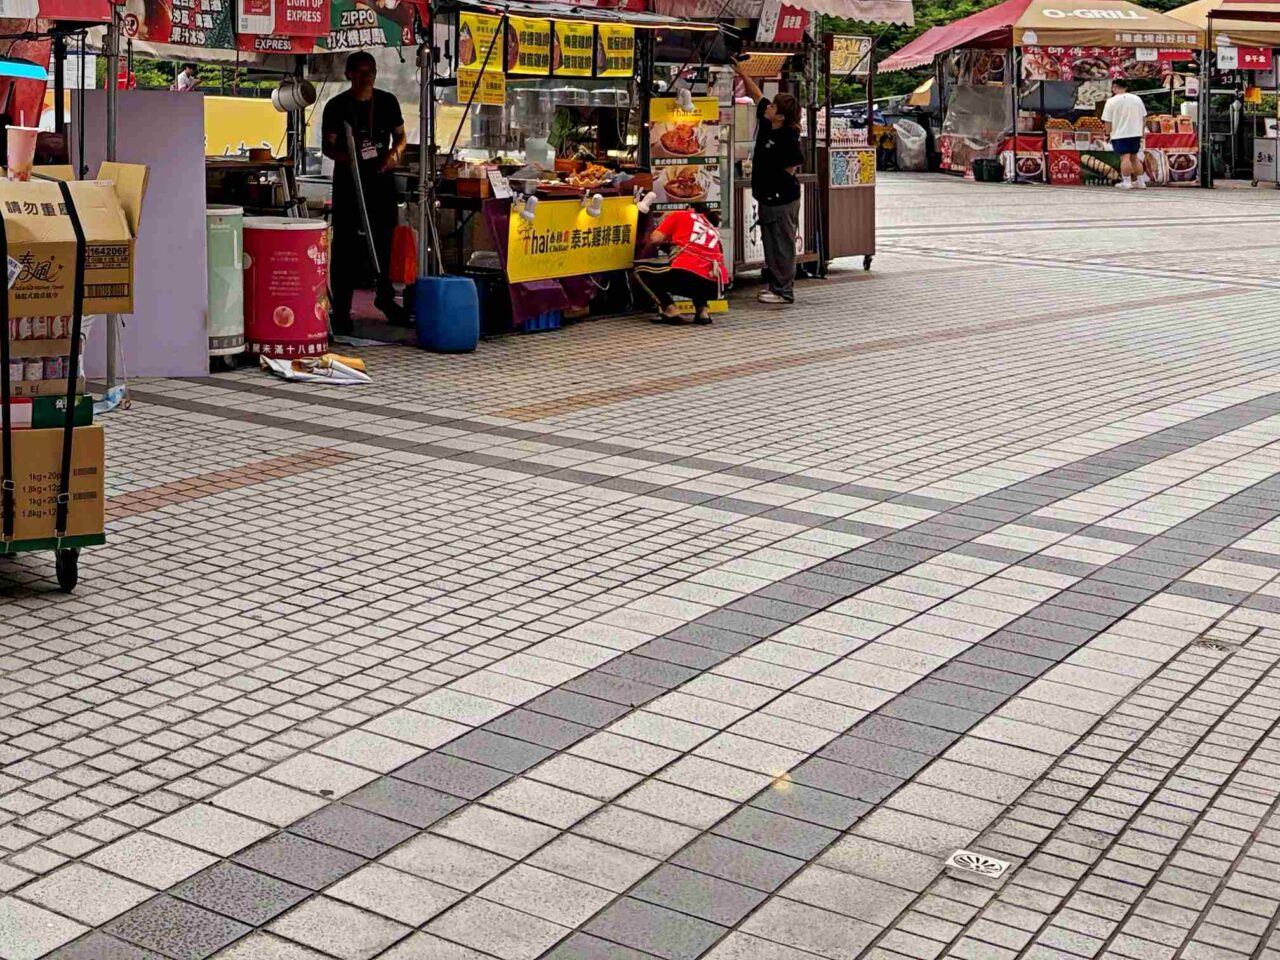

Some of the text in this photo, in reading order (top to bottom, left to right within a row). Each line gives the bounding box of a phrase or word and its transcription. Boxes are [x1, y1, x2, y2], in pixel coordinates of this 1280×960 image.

[286, 9, 322, 23] EXPRESS
[341, 9, 375, 26] ZIPPO
[1042, 8, 1148, 21] O-GRILL
[704, 157, 717, 165] 120
[571, 224, 632, 250] 泰式雞排專賣
[17, 251, 55, 283] 春風
